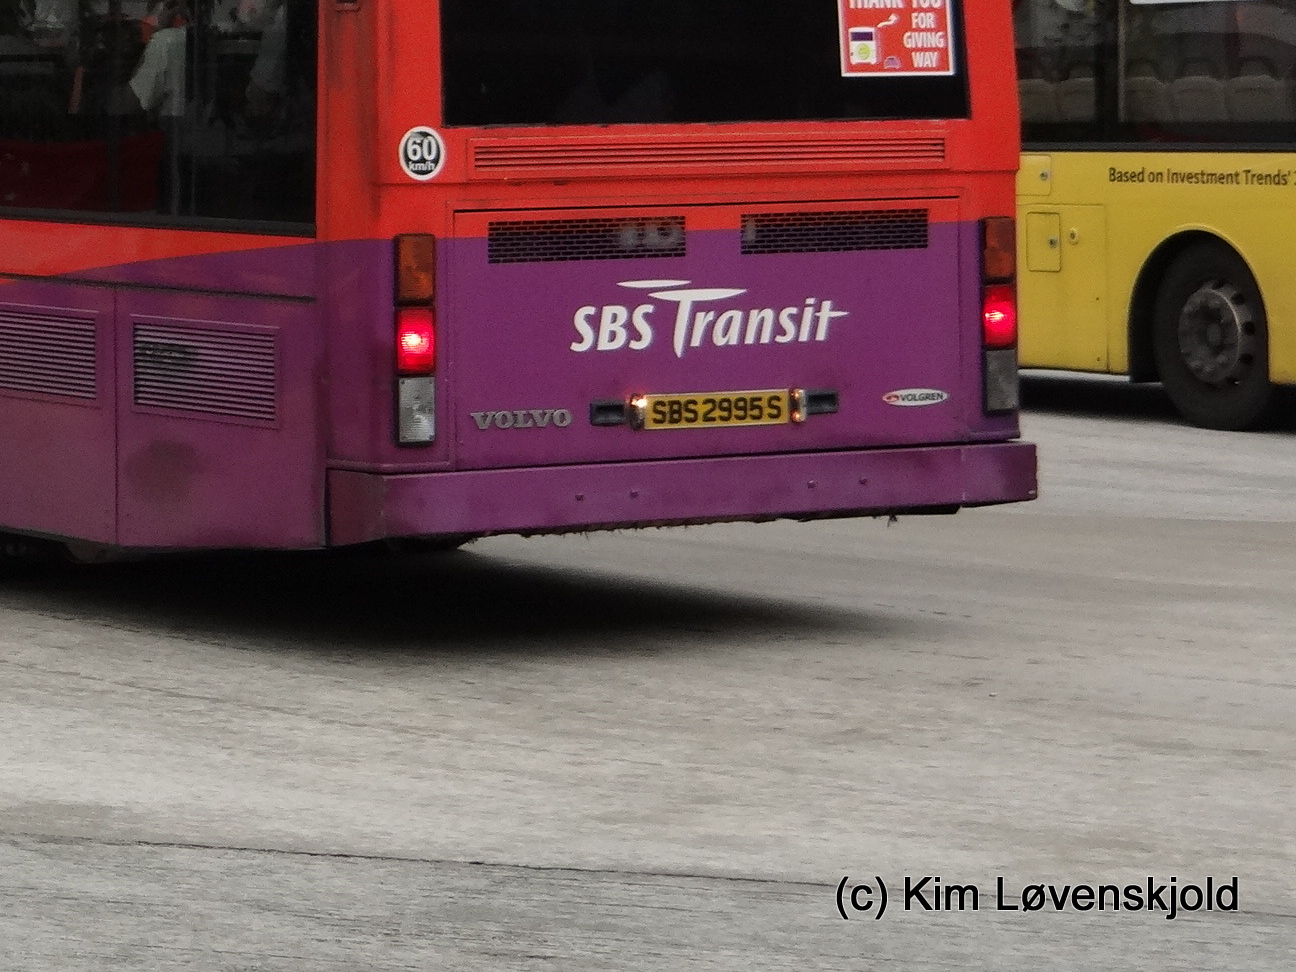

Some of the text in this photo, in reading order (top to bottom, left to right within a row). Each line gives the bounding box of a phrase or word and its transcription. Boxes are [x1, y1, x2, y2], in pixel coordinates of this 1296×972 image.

[911, 12, 936, 29] FOR
[903, 31, 945, 49] GIVING
[911, 51, 938, 68] WAY
[407, 134, 437, 161] 60
[408, 161, 435, 170] km/h
[1108, 167, 1145, 183] Based
[1148, 170, 1163, 183] on
[1167, 168, 1240, 184] Investment
[1243, 169, 1291, 186] Trends'
[569, 287, 850, 359] SBS Transit
[900, 393, 944, 402] VOLGREN
[471, 409, 573, 430] VOLVO
